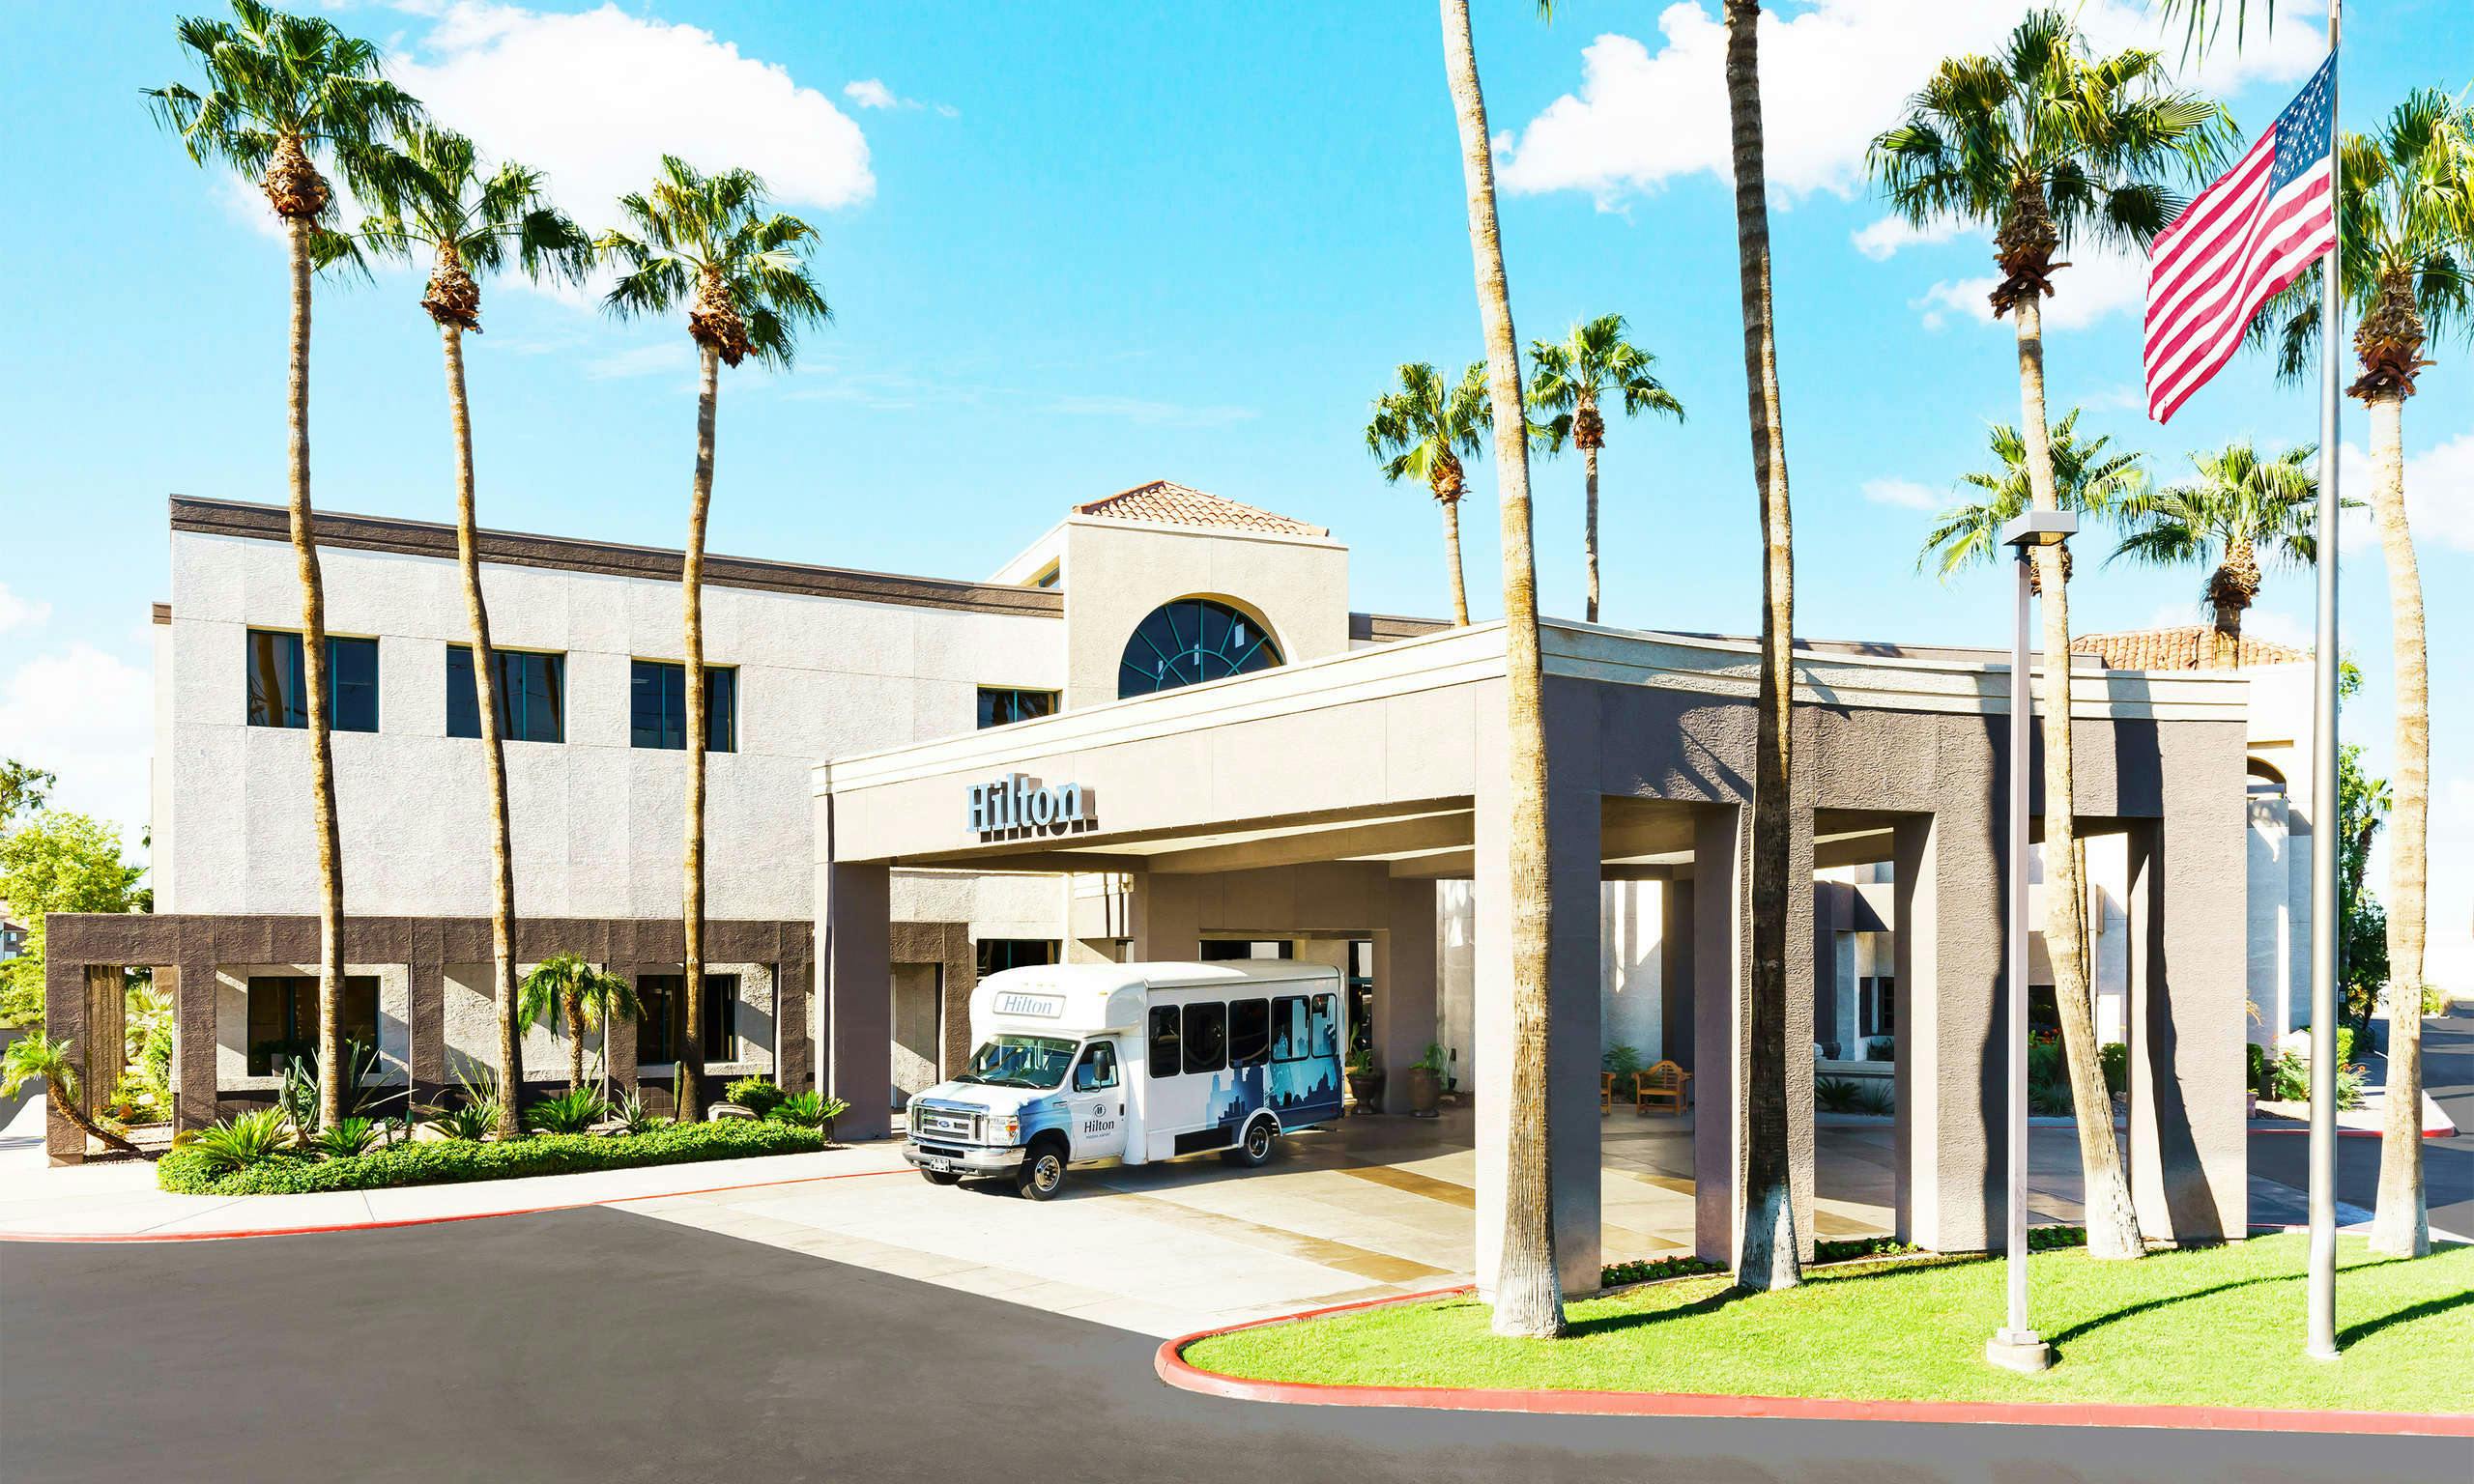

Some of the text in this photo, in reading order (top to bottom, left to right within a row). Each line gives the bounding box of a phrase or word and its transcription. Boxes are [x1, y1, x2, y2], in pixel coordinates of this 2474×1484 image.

[966, 772, 1086, 835] Hilton
[1004, 995, 1052, 1014] Hilton
[1084, 1120, 1114, 1133] Hilton
